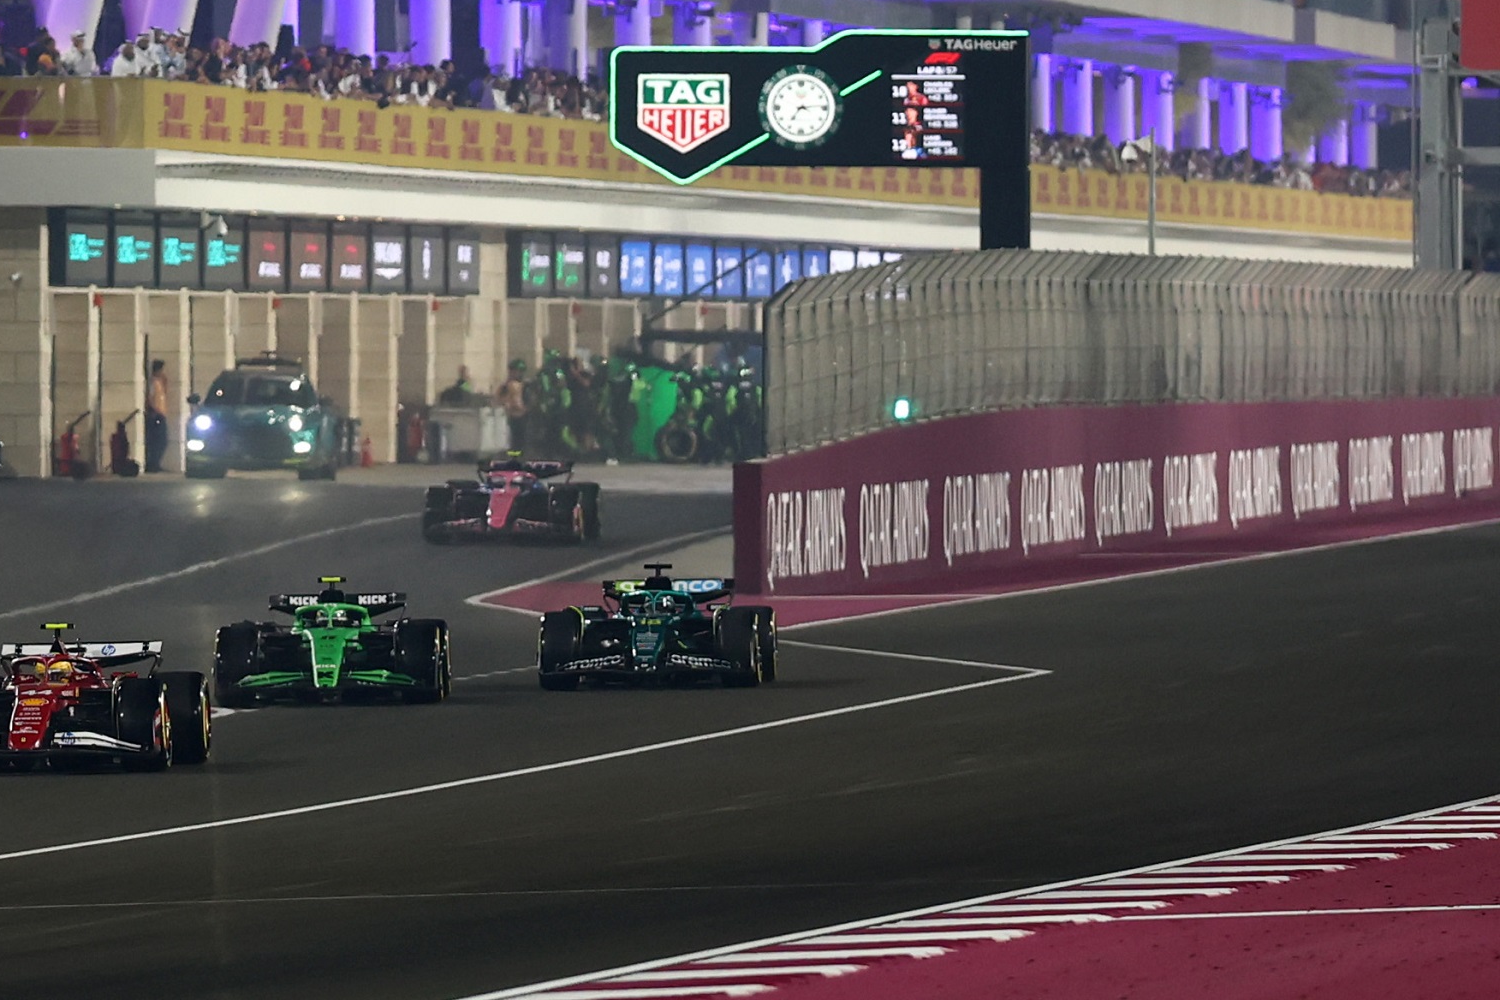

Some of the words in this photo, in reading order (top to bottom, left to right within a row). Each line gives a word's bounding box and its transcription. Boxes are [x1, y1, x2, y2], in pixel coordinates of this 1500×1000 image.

[645, 80, 723, 104] TAG
[643, 109, 724, 146] HEUER
[943, 475, 974, 567] QATAR
[1021, 468, 1049, 557] QATAR
[767, 491, 802, 591] QATAR
[804, 487, 846, 575] AIRWAYS
[860, 483, 891, 579] QATAR
[893, 479, 930, 564] AIRWAYS
[289, 596, 318, 605] KICK
[358, 594, 387, 605] KICK
[564, 654, 621, 671] aramco
[671, 653, 731, 669] aramco
